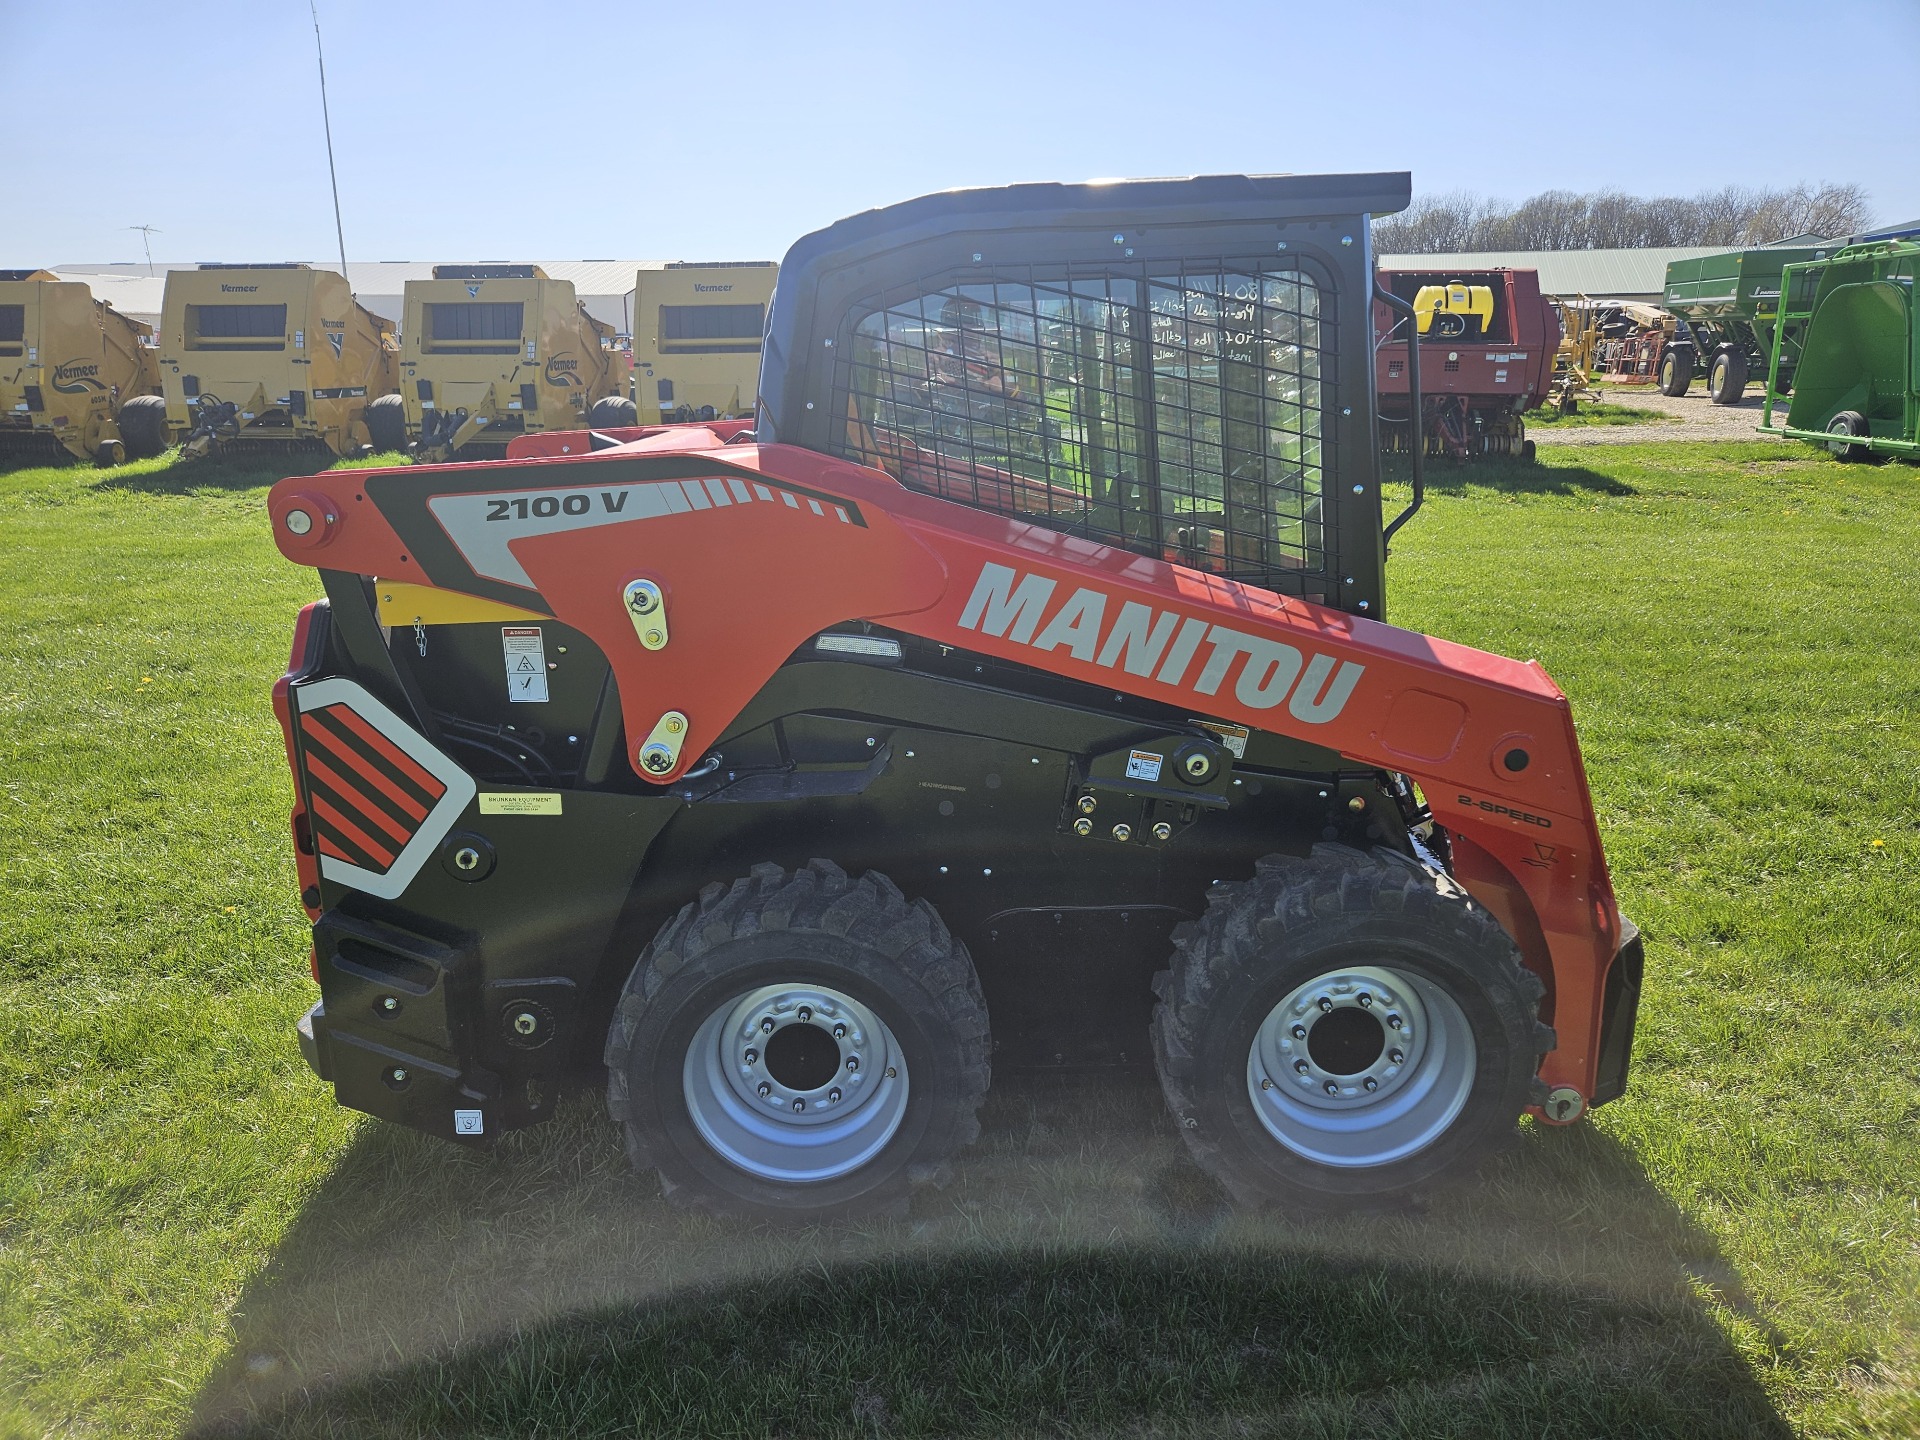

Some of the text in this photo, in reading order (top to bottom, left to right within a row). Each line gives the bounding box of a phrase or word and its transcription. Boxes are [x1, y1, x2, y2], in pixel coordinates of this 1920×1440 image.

[221, 284, 258, 292] Vermeer
[694, 284, 733, 292] Vermeer
[321, 318, 345, 328] Vermeer
[548, 356, 578, 371] Vermeer
[54, 364, 98, 380] Vermeer
[486, 491, 629, 522] 2100 V
[957, 561, 1366, 725] MANITOU
[1458, 795, 1552, 828] 2-SPEED
